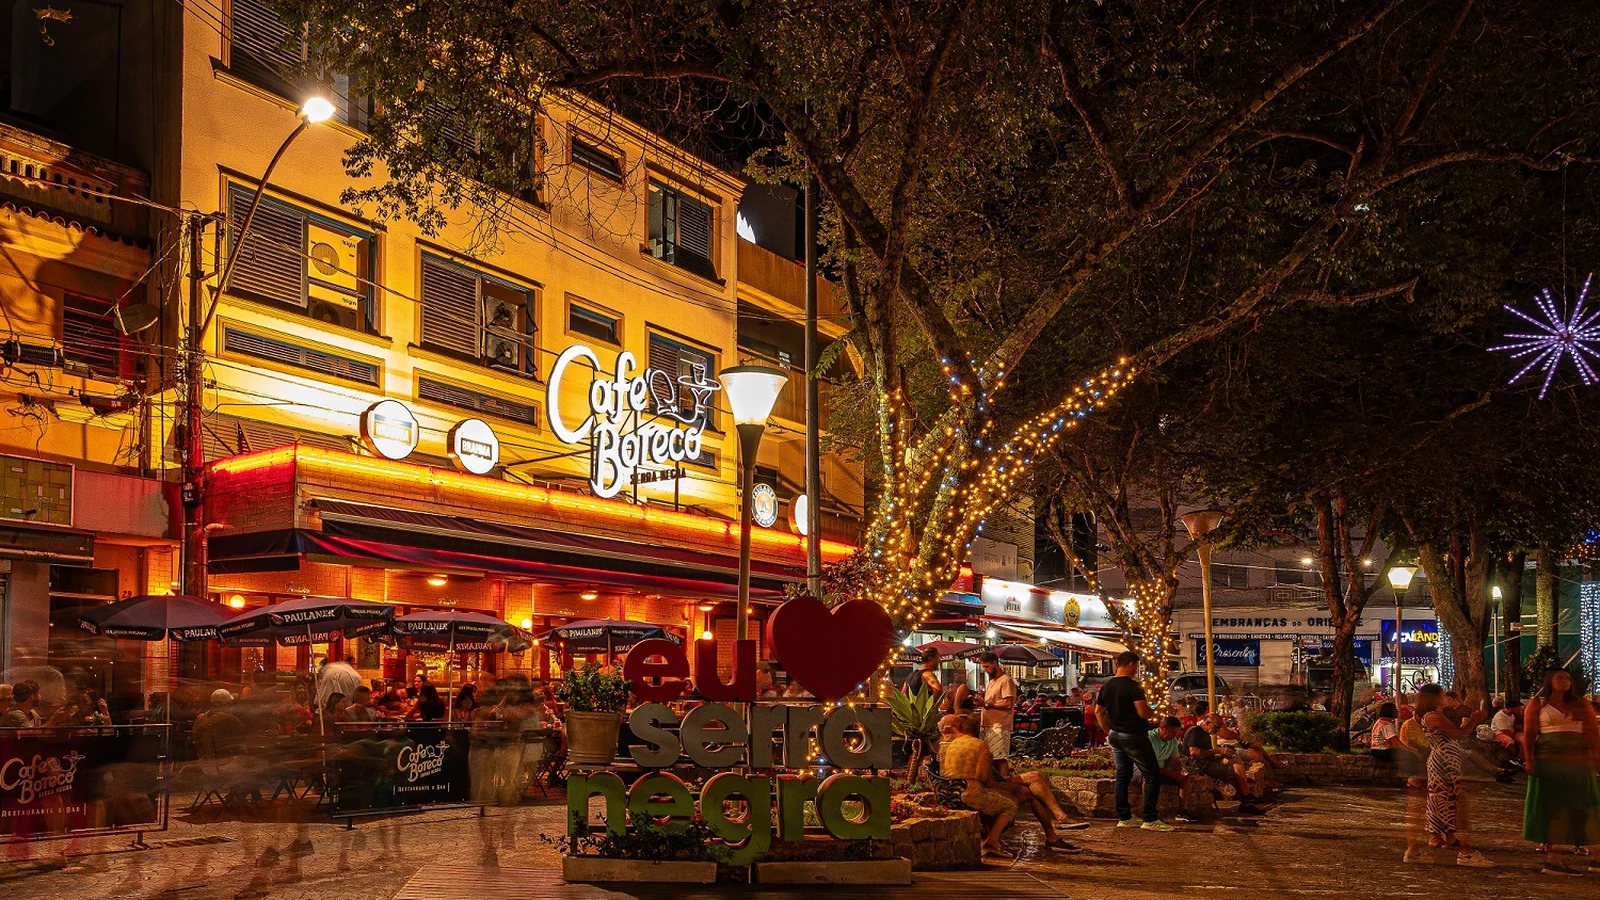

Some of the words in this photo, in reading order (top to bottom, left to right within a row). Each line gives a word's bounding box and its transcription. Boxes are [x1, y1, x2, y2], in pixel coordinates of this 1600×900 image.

[284, 610, 335, 623] PAULANER
[1209, 617, 1288, 628] EMBRANÇAS
[407, 622, 448, 631] PAULANER
[184, 629, 217, 638] PAULAN
[623, 638, 757, 701] eu
[628, 702, 893, 769] serra
[567, 771, 892, 866] negra
